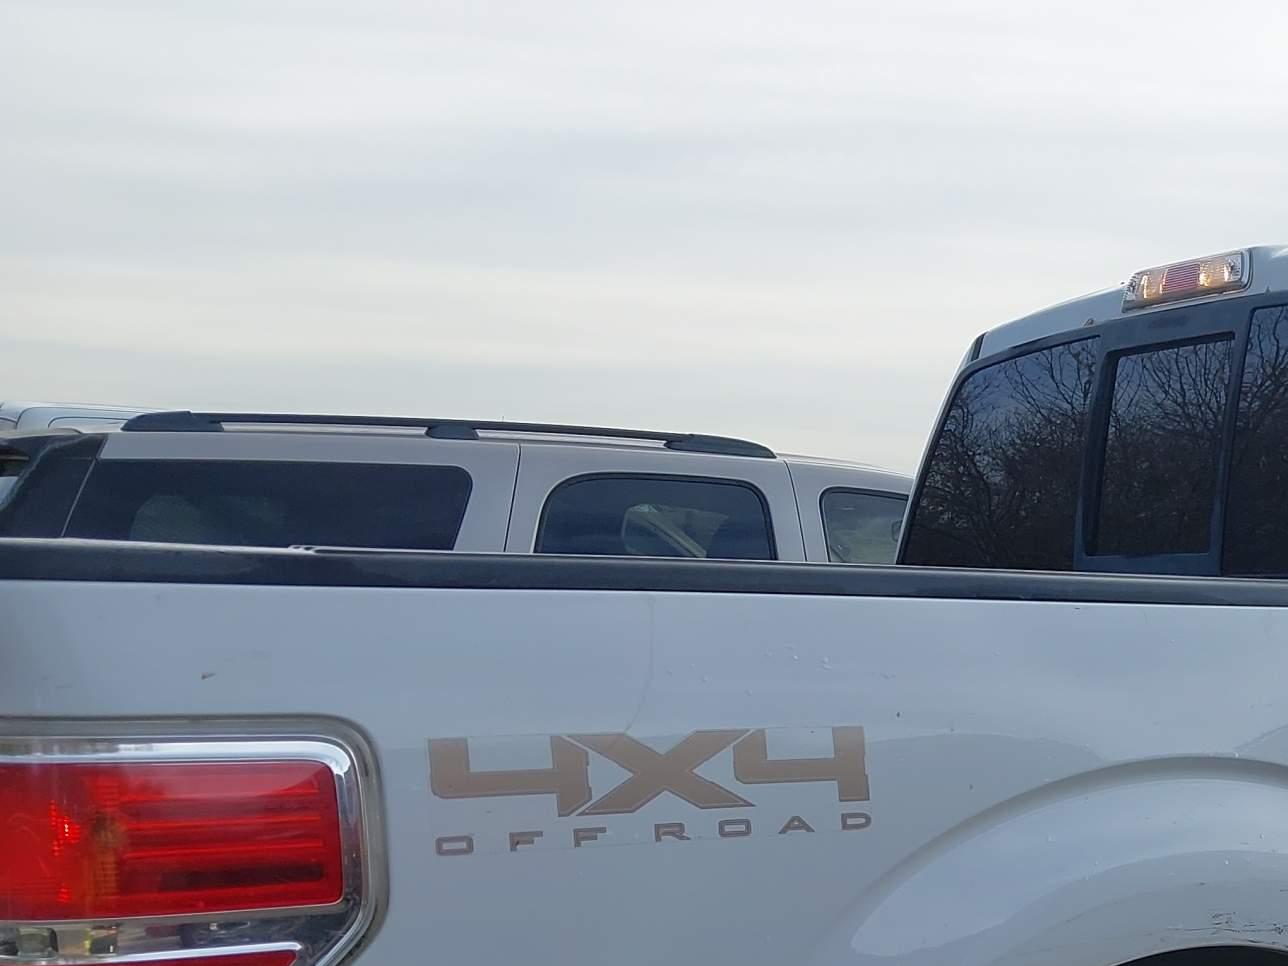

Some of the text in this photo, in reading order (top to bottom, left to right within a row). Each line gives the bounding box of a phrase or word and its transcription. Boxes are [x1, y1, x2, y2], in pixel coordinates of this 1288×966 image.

[427, 725, 870, 817] 4X4
[435, 812, 873, 857] OFF ROAD
